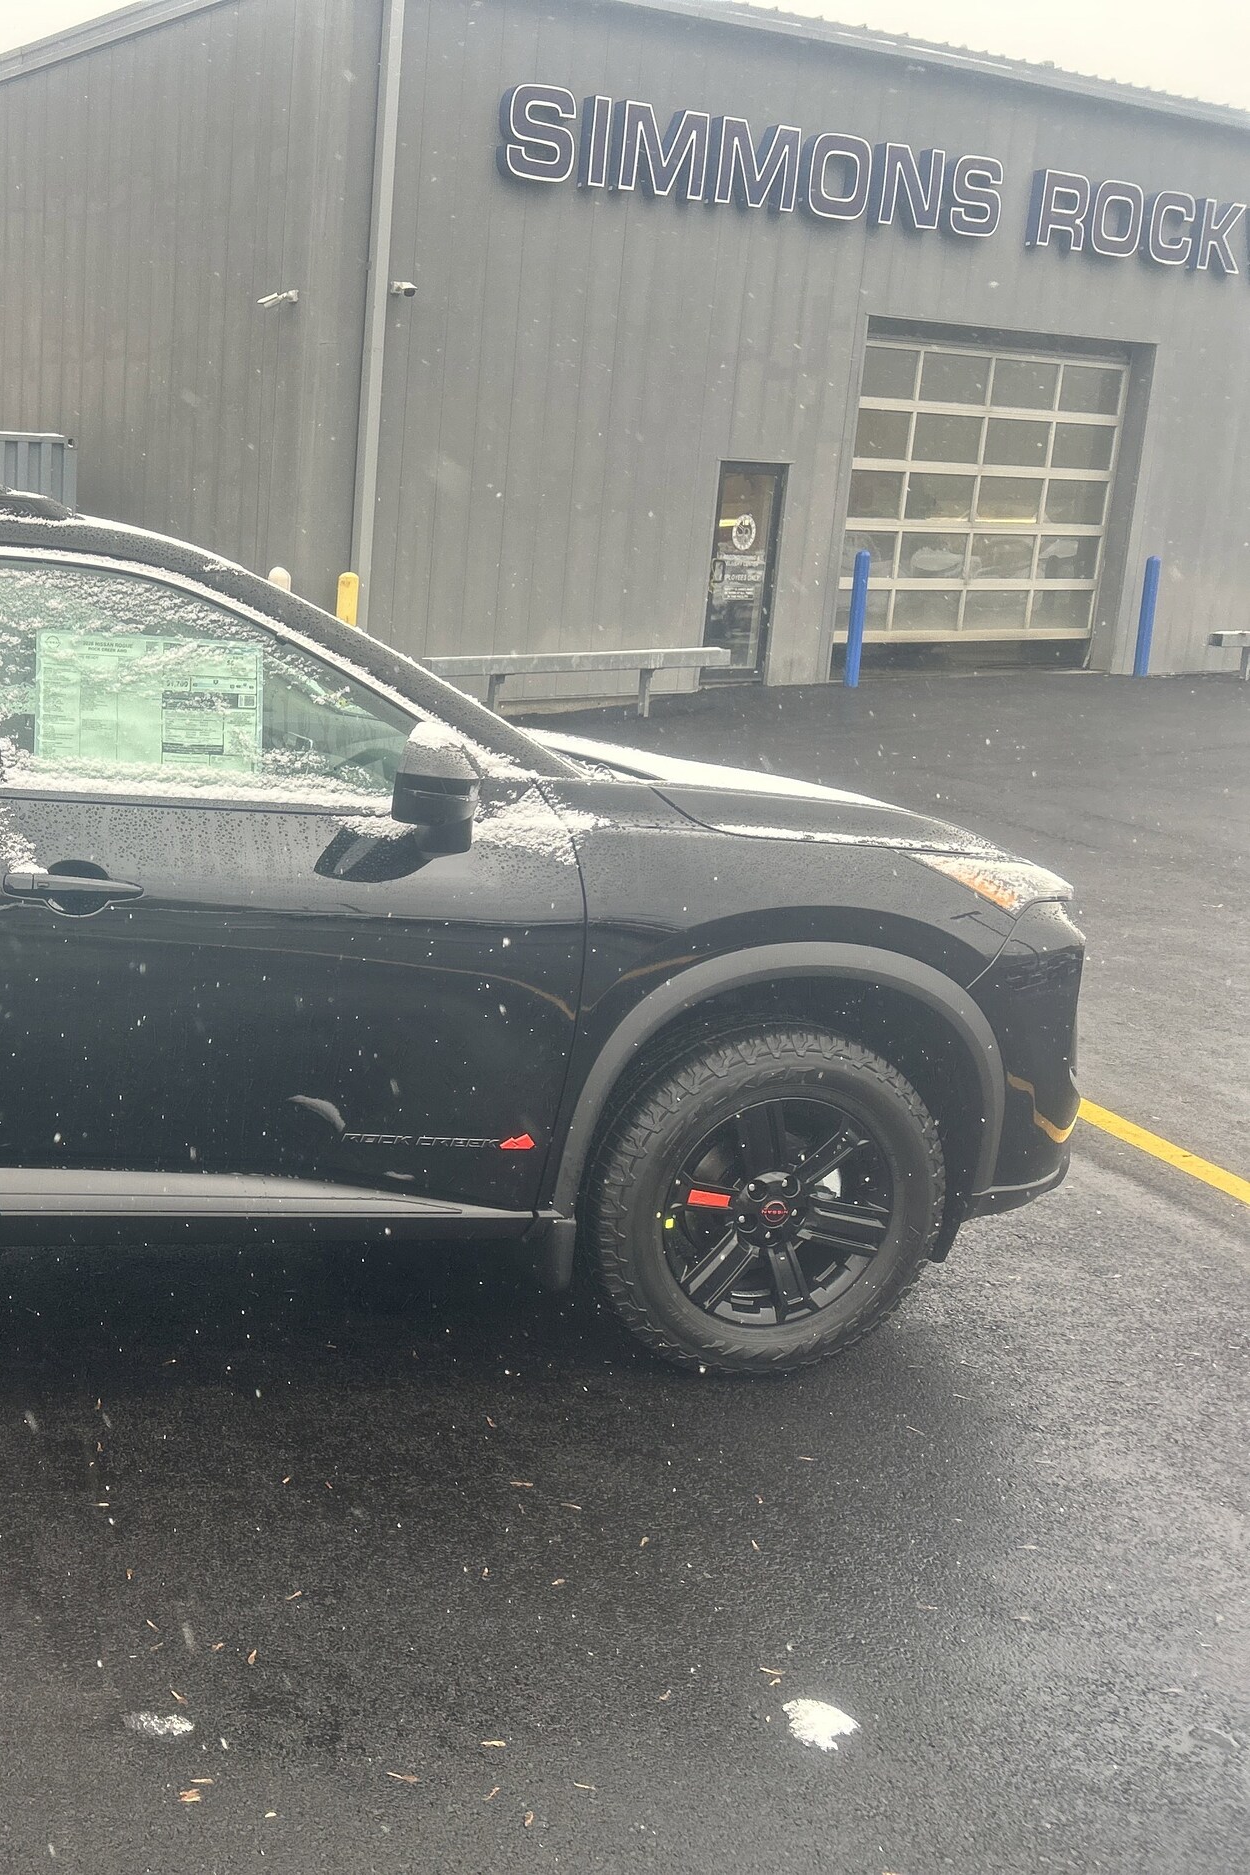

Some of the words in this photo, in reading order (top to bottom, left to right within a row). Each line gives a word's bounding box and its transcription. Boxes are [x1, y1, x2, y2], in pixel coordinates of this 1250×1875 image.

[502, 82, 1005, 238] SIMMONS
[1033, 168, 1250, 275] ROCK
[341, 1132, 413, 1146] ROCK
[415, 1135, 500, 1149] CREEK
